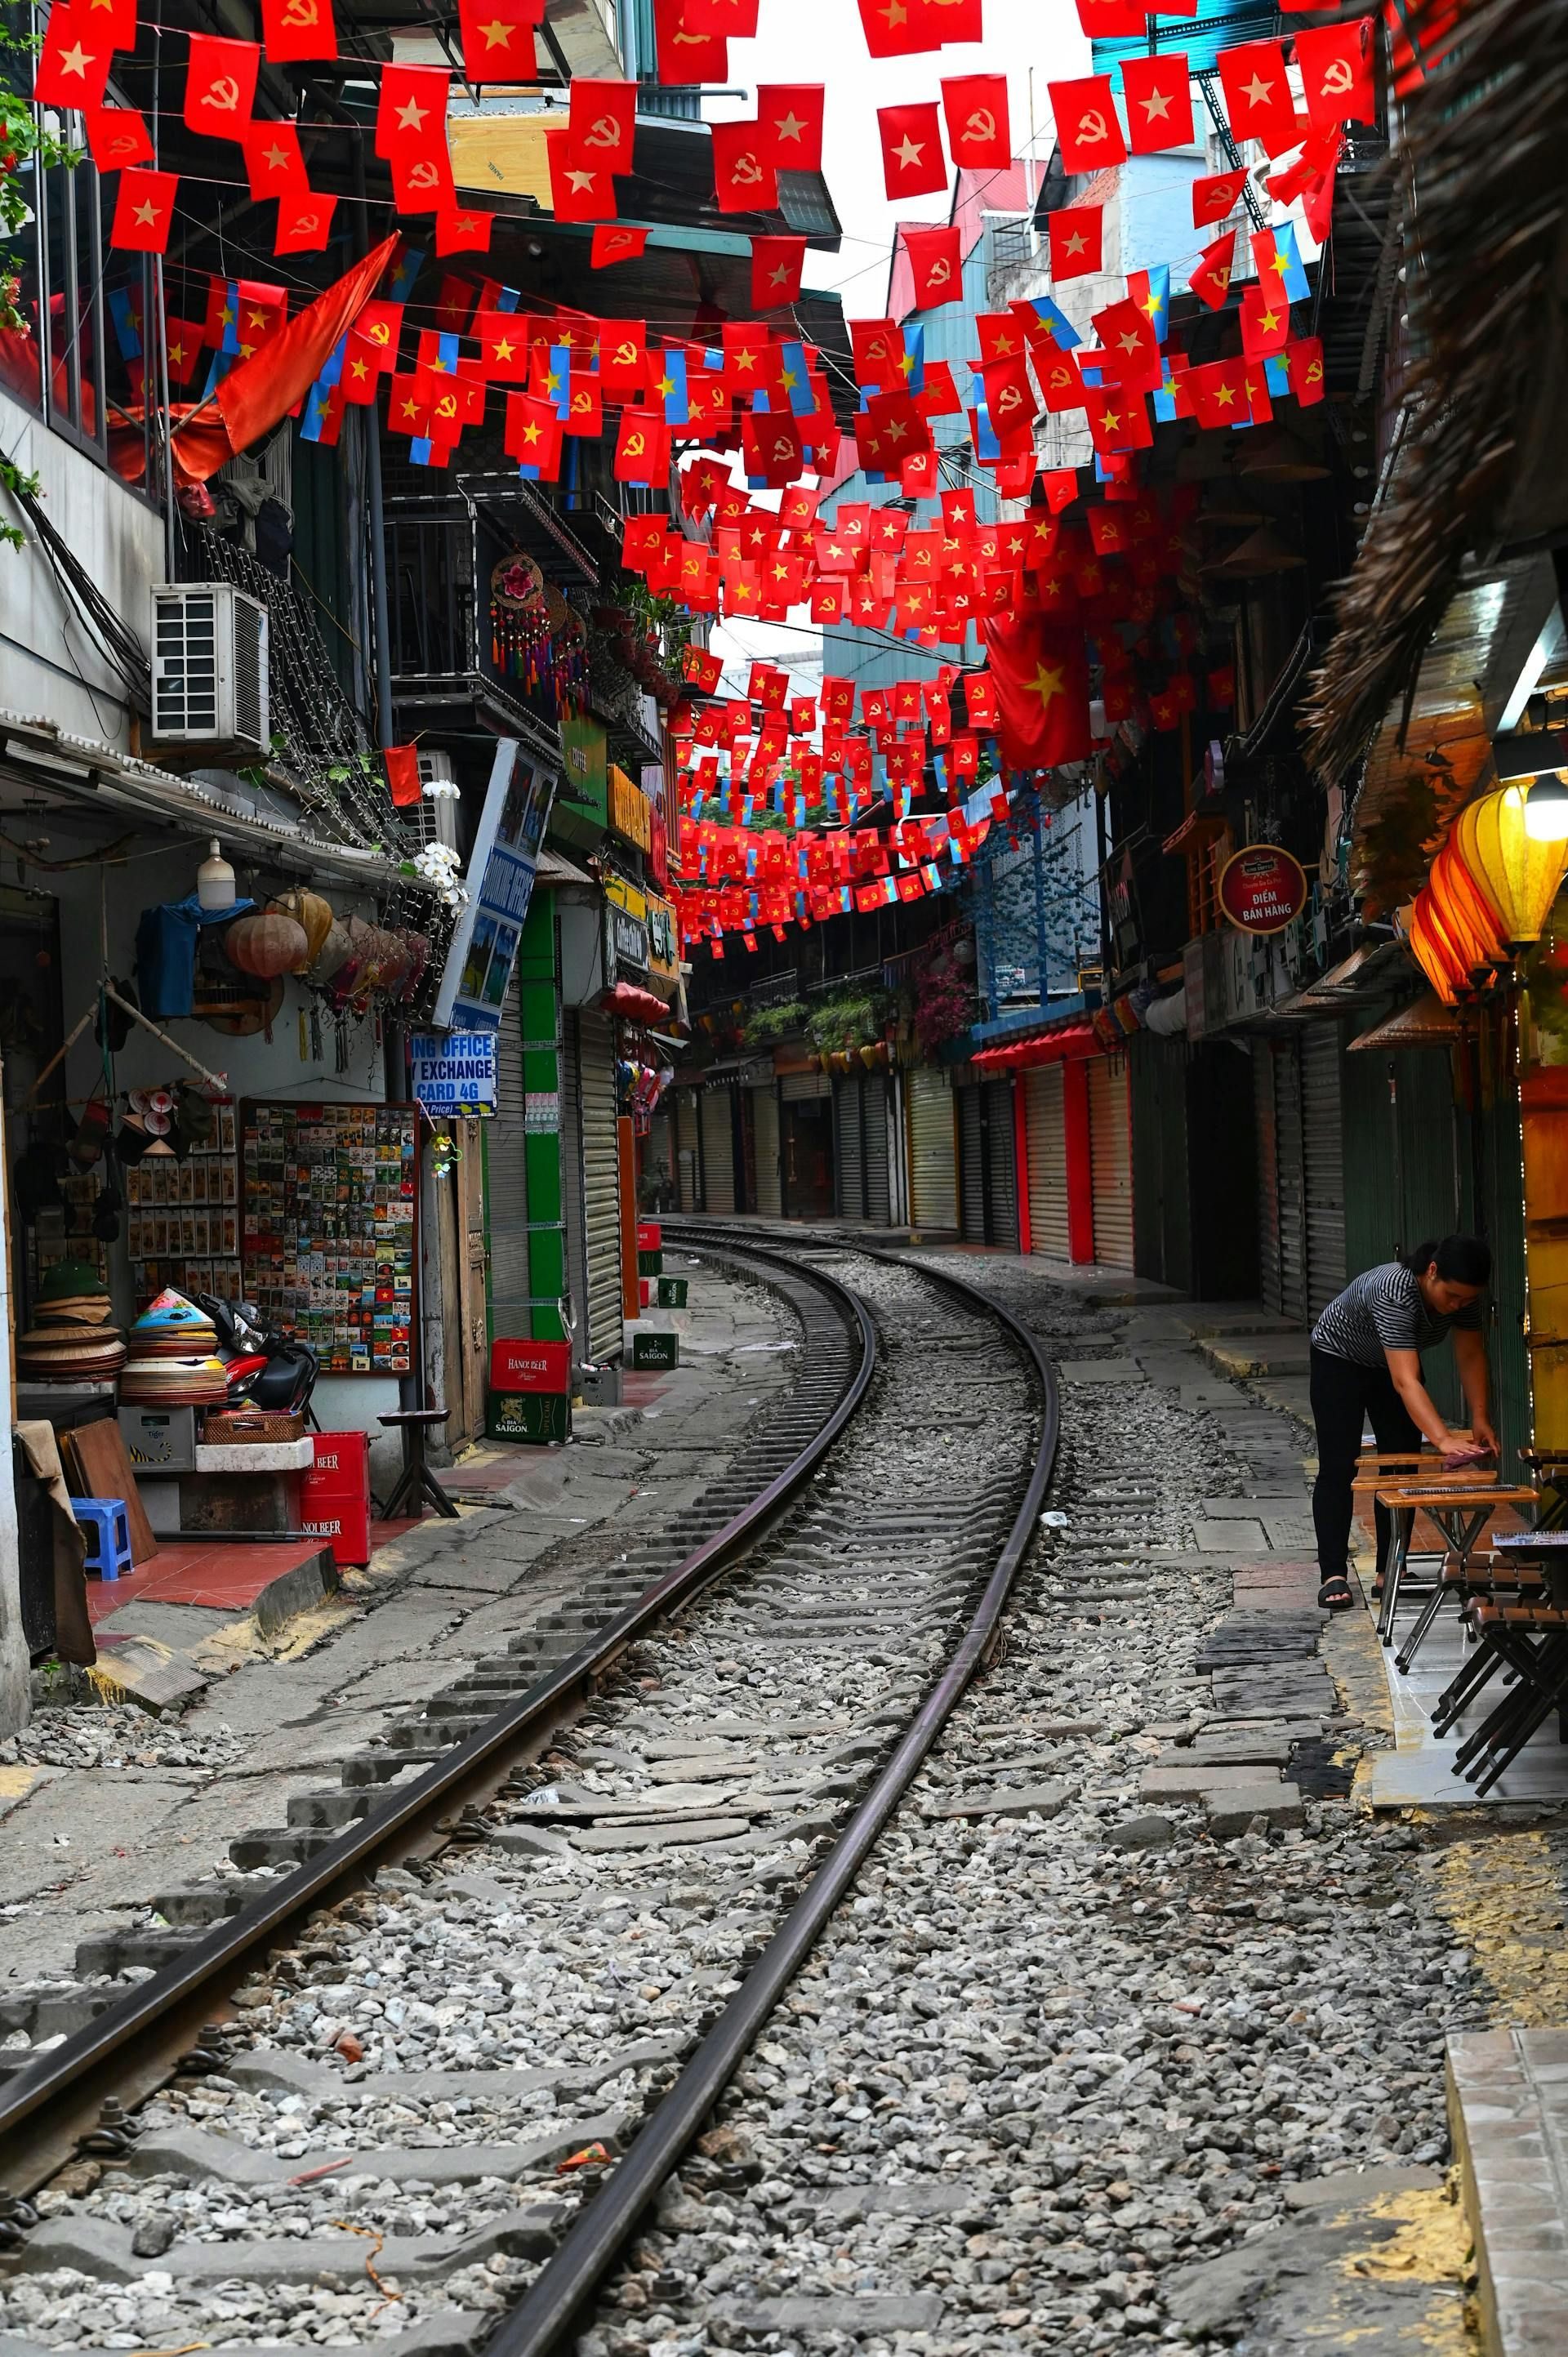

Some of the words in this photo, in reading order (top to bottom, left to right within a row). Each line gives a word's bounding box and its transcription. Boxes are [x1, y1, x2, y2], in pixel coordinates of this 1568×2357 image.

[481, 853, 515, 910] BOOKING
[506, 866, 533, 917] OFFICE
[1252, 889, 1277, 905] ĐIỂM
[1243, 906, 1263, 921] BÁN
[1264, 902, 1291, 917] HÀNG
[442, 1036, 492, 1058] OFFICE
[421, 1059, 492, 1080] EXCHANGE
[416, 1083, 455, 1101] CARD
[460, 1082, 479, 1100] 4G
[430, 1104, 453, 1115] Price)
[639, 1352, 668, 1360] SAIGON
[508, 1358, 530, 1370] HANOI
[530, 1359, 547, 1371] BEER
[148, 1430, 165, 1439] Tiger
[495, 1424, 528, 1432] SAIGON
[317, 1454, 339, 1470] BEER
[301, 1522, 318, 1534] NOI
[318, 1520, 342, 1535] BEER
